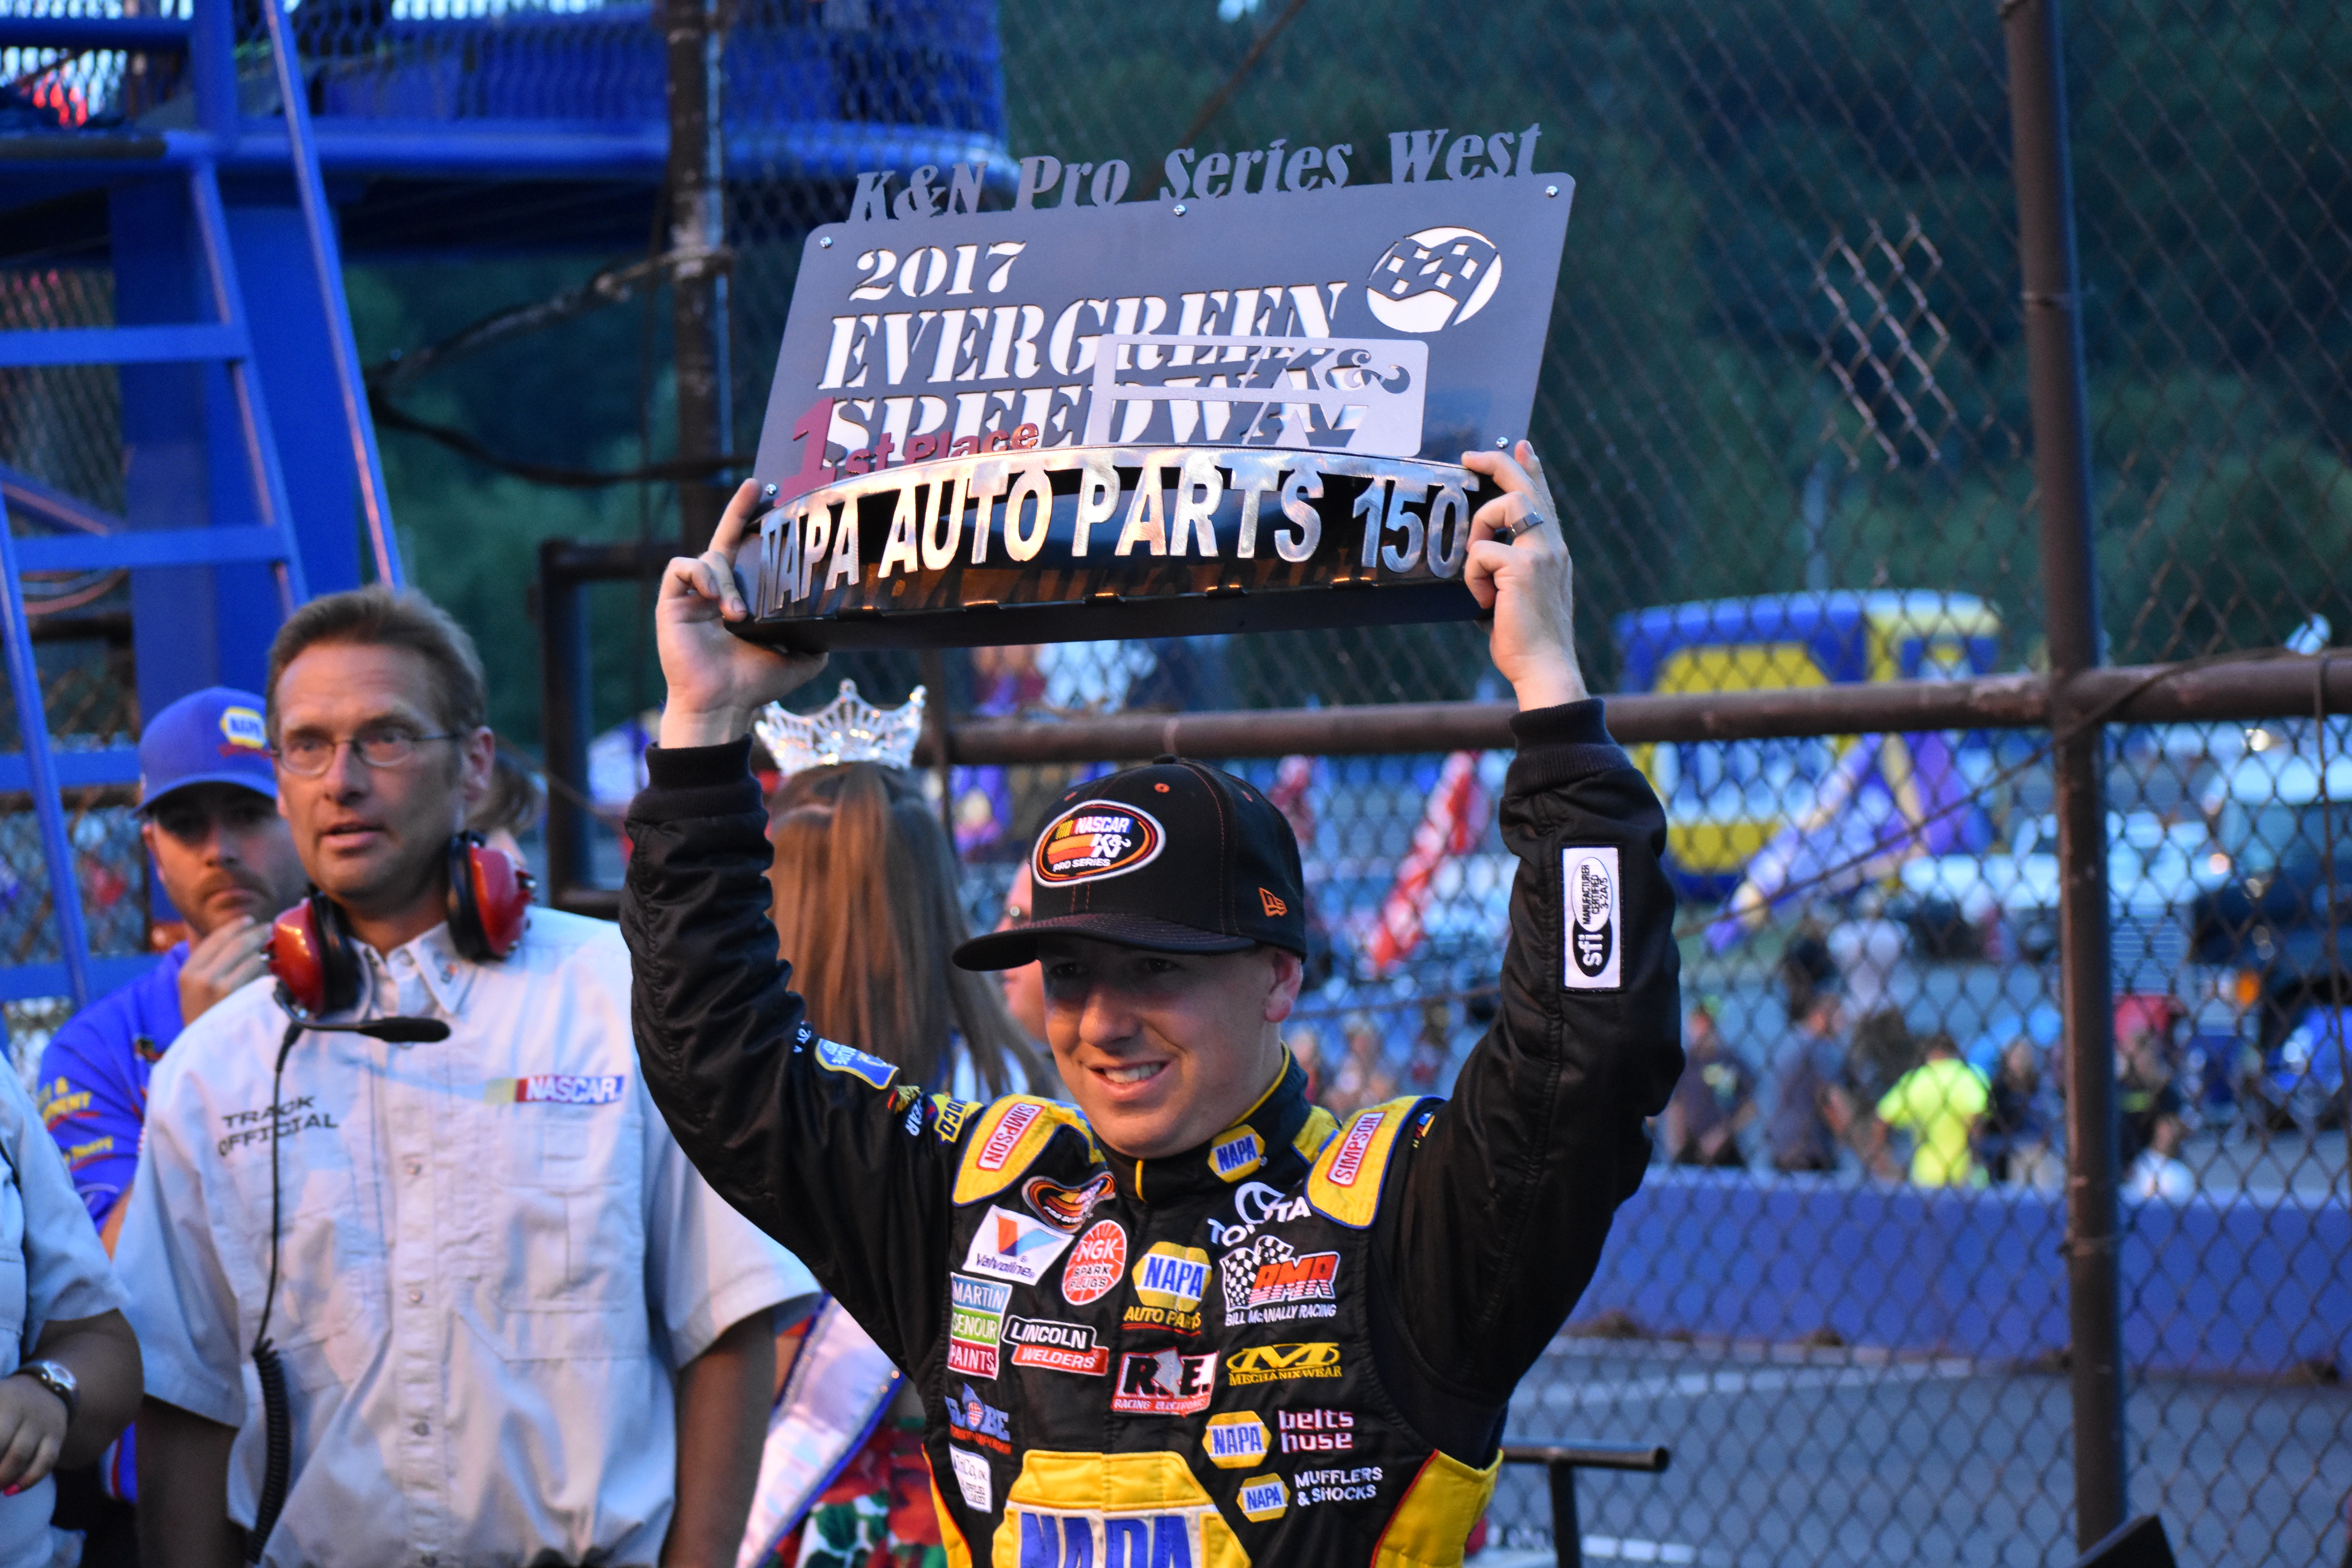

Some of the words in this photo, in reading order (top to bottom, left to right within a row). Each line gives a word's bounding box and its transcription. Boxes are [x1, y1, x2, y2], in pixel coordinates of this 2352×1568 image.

[846, 161, 989, 223] K&N
[1011, 155, 1130, 212] Pro
[1159, 139, 1352, 199] Series
[1388, 123, 1542, 184] West
[848, 241, 1026, 301] 2017
[817, 281, 1348, 390] EVERGREEN
[904, 423, 1040, 466] Place
[760, 495, 860, 613] NAPA
[878, 466, 1053, 578] AUTO
[1072, 462, 1324, 563] PARTS
[1353, 472, 1470, 579] 150
[1074, 816, 1130, 834] NASCAR
[1053, 860, 1071, 872] PRO
[1072, 858, 1111, 868] SERIES
[1591, 875, 1600, 915] CERTIFIED
[526, 1076, 618, 1103] NASCAR
[222, 1096, 315, 1128] TRACK
[218, 1112, 339, 1156] OFFICIAL
[984, 1105, 1036, 1163] SIMPSON
[1216, 1136, 1258, 1172] NAPA
[1334, 1117, 1379, 1180] SIMPSON
[1076, 1238, 1118, 1262] NGK
[976, 1253, 1033, 1278] Valvoline
[1073, 1264, 1111, 1277] SPARK
[1143, 1256, 1204, 1298] NAPA
[953, 1281, 1005, 1308] MARTIN
[1069, 1278, 1107, 1292] PLUGS
[952, 1312, 998, 1339] SENOUR
[1123, 1306, 1165, 1323] AUTO
[1225, 1311, 1246, 1327] BILL
[1298, 1304, 1337, 1319] RACING
[1010, 1321, 1087, 1349] LINCOLN
[950, 1344, 995, 1371] PAINTS
[1021, 1347, 1096, 1369] WELDERS
[1113, 1399, 1151, 1409] RACING
[1278, 1408, 1354, 1430] belts
[1212, 1425, 1262, 1454] NAPA
[1294, 1466, 1383, 1488] MUFFLERS
[1246, 1486, 1283, 1511] NAPA
[1297, 1491, 1311, 1506] &
[1311, 1484, 1377, 1503] SHOCKS
[1020, 1512, 1192, 1568] NAPA
